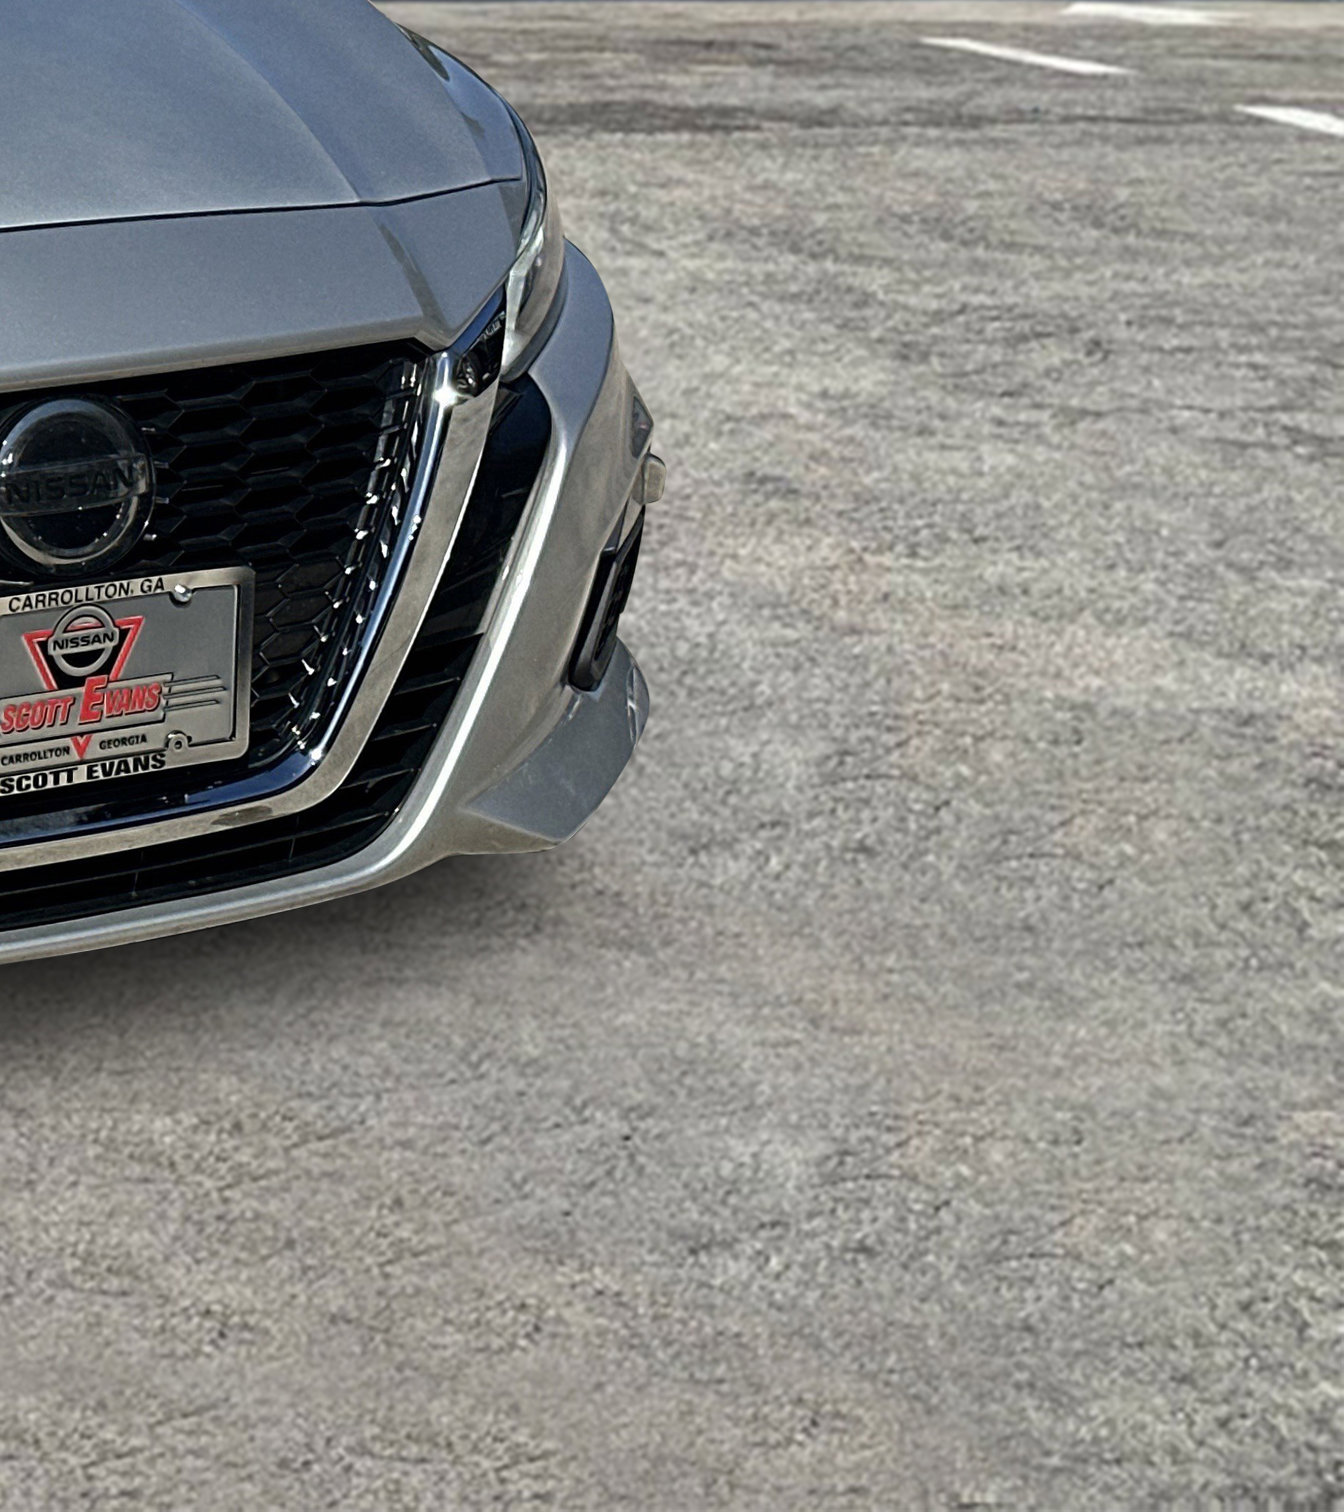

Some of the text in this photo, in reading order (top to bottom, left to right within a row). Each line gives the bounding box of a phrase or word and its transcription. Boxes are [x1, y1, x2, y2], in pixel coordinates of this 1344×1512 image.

[4, 465, 134, 505] NISSAN
[140, 577, 165, 594] GA
[53, 632, 114, 651] NISSAN
[0, 675, 162, 733] SCOTT EVANS
[0, 734, 148, 766] CARROLLTON GEORGIA
[0, 753, 167, 795] SCOTT EVANS
